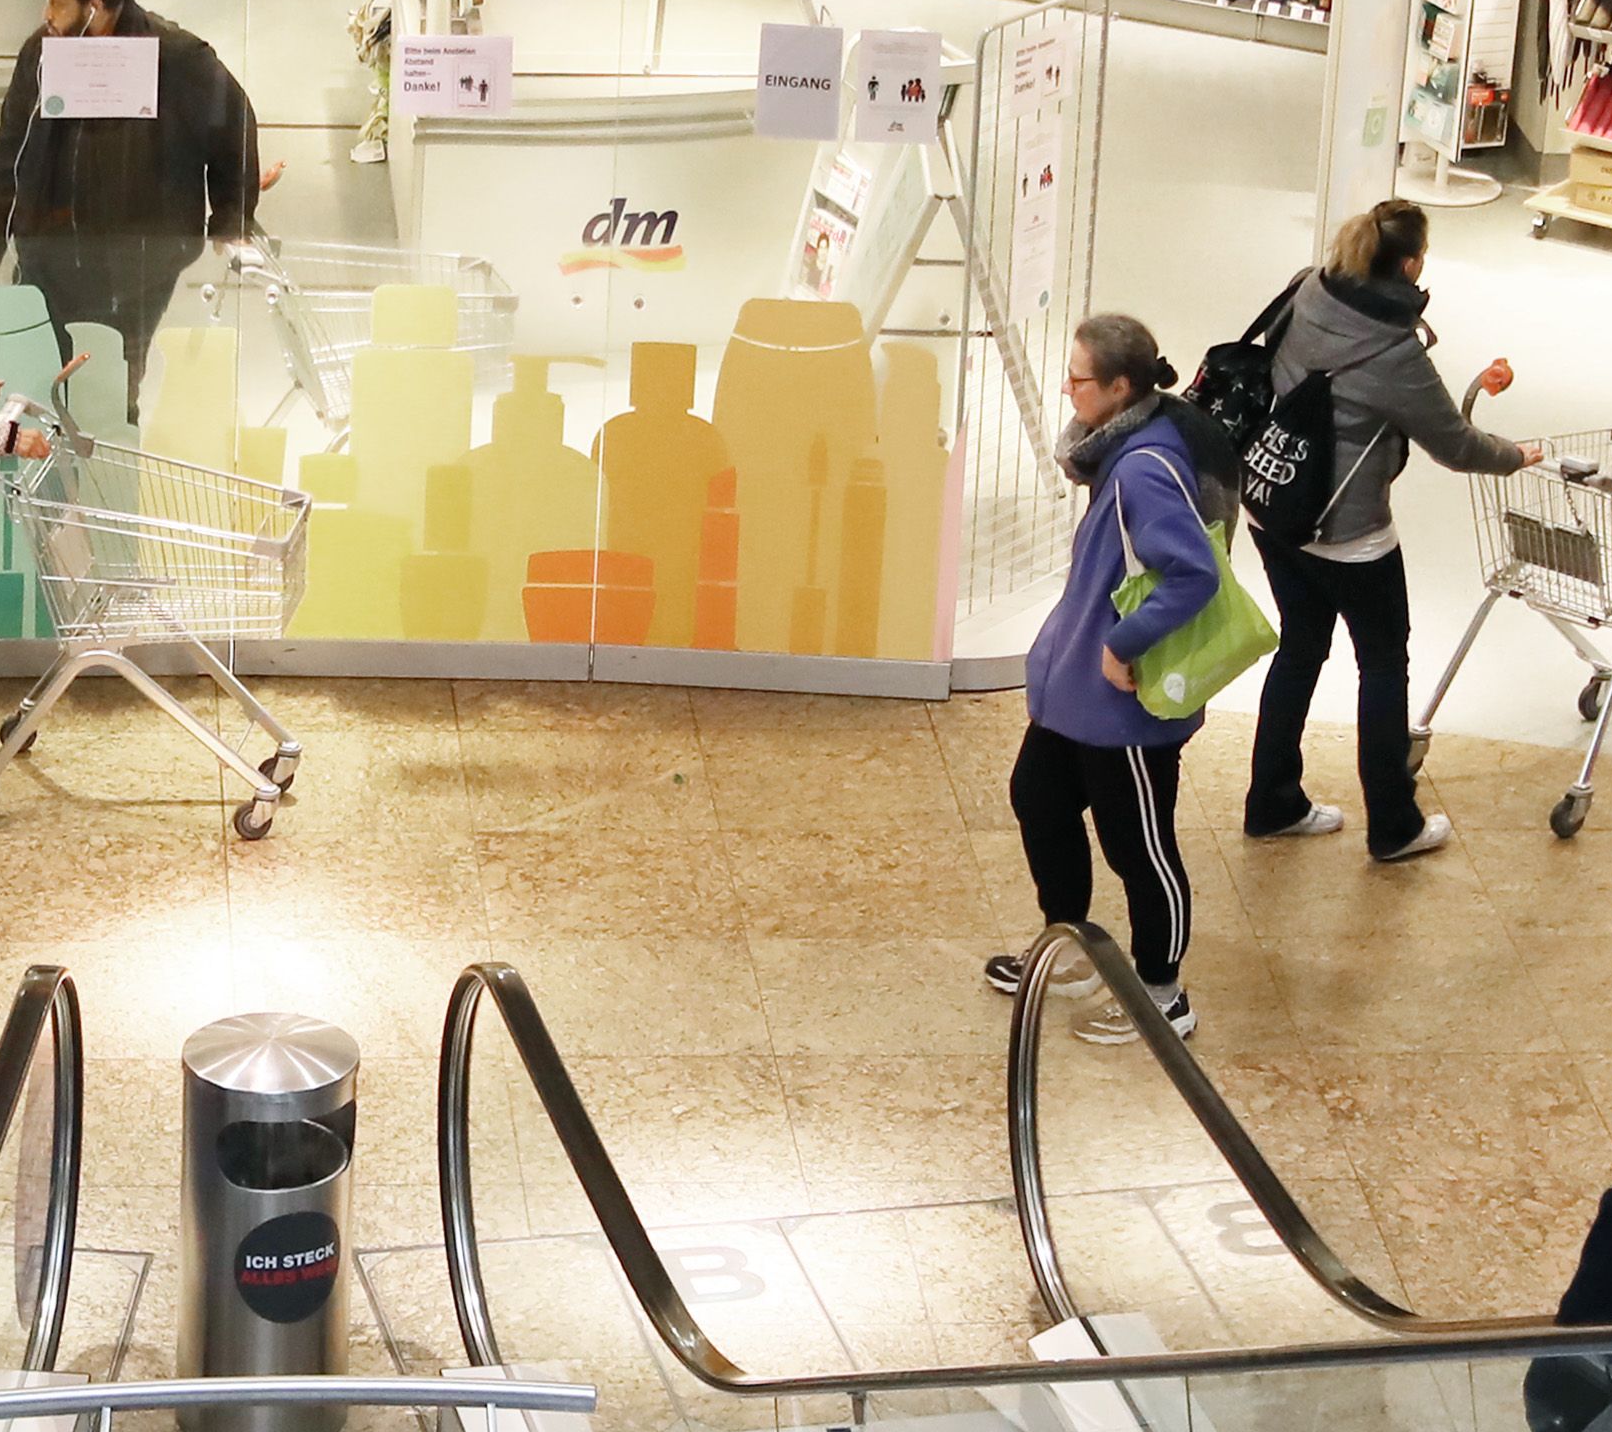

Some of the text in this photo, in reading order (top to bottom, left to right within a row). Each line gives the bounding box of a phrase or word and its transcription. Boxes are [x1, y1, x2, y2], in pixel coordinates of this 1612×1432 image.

[404, 81, 441, 92] Danke!
[765, 74, 831, 91] EINGANG
[582, 197, 679, 246] dm
[245, 1241, 335, 1269] ICH STECK
